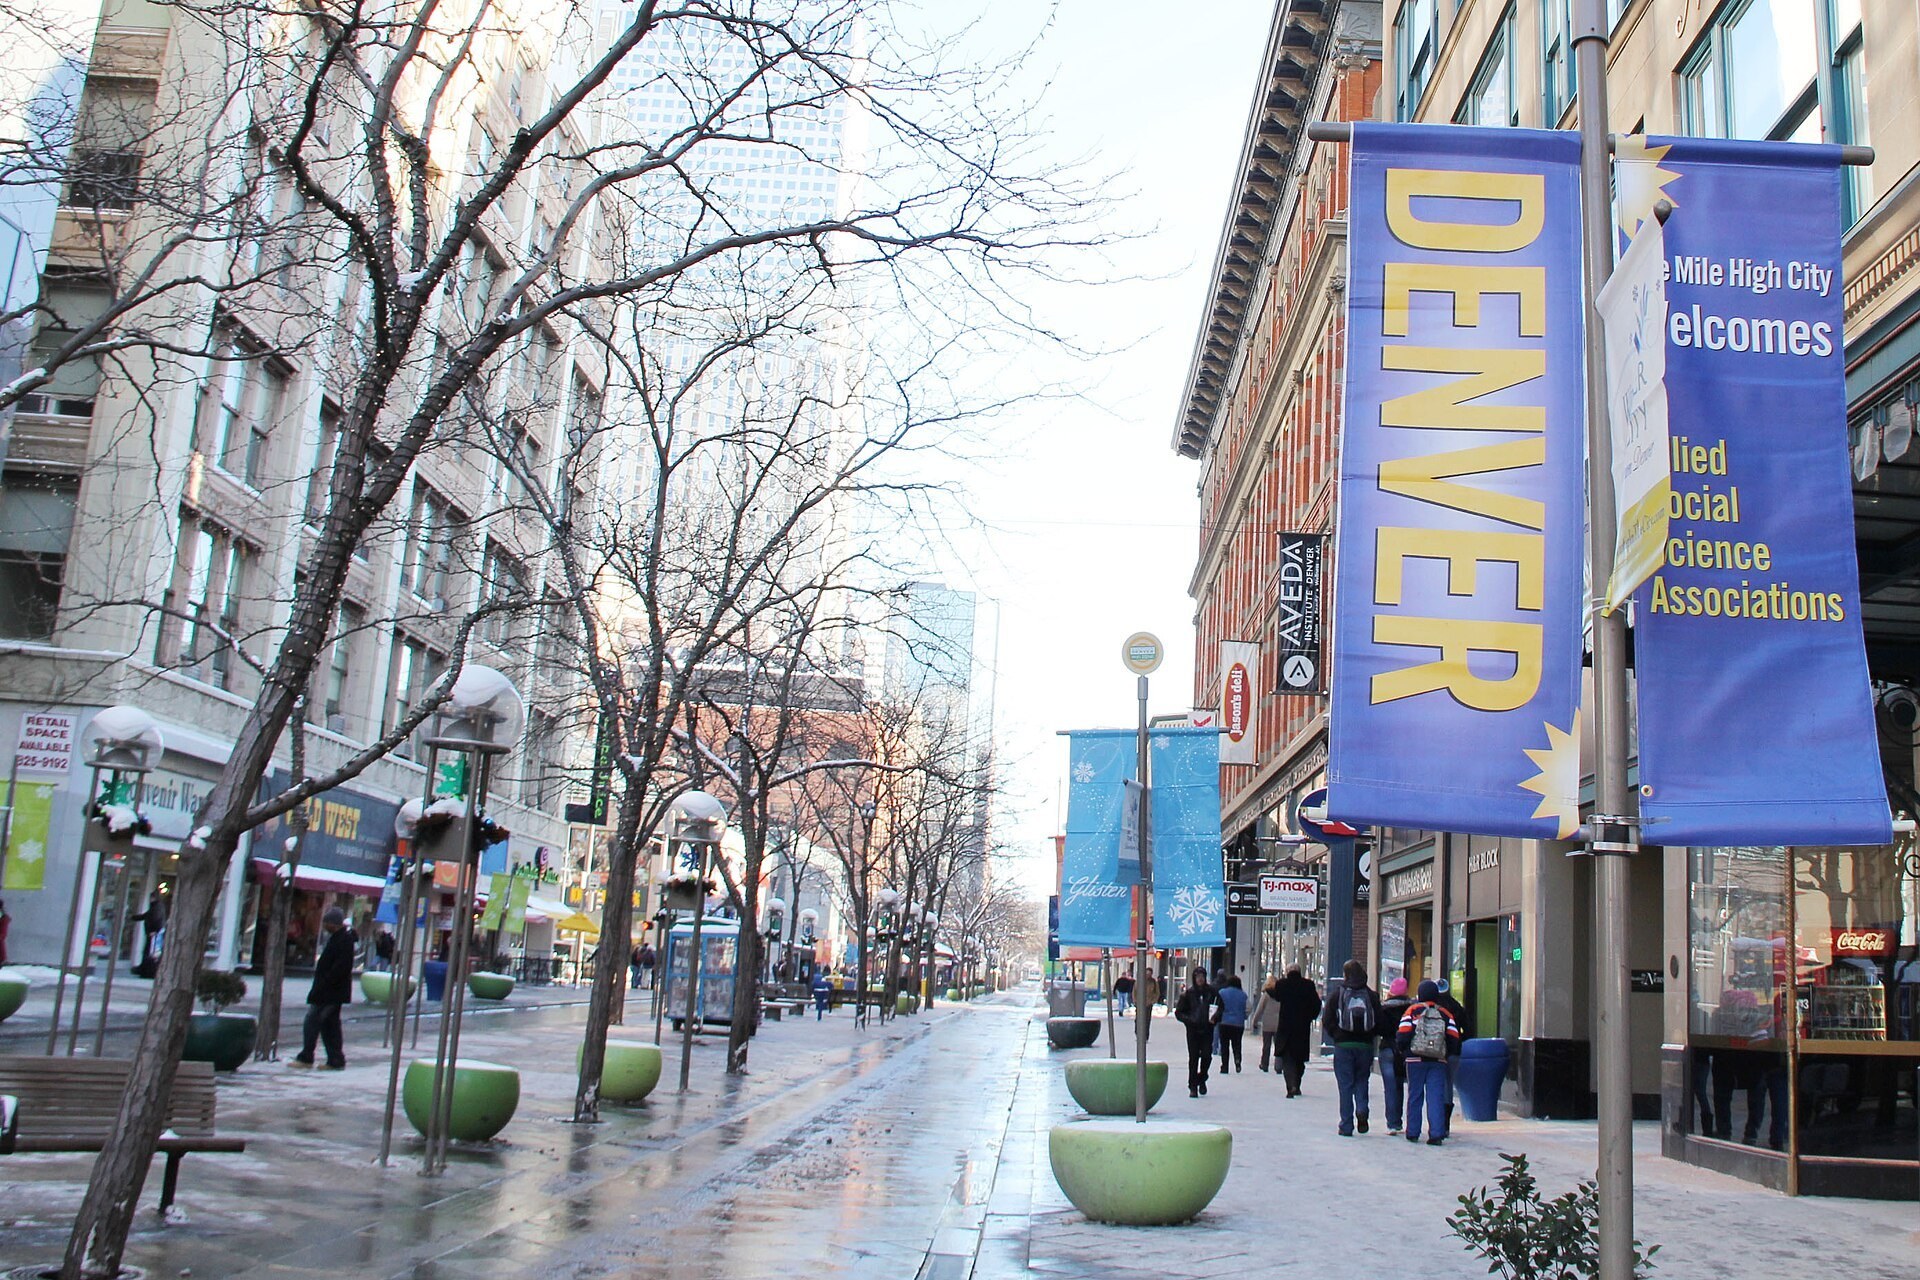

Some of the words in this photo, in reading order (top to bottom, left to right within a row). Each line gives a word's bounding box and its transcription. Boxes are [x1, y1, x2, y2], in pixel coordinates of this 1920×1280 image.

[1674, 255, 1724, 287] Mile
[1729, 258, 1783, 295] High
[1787, 261, 1834, 298] City
[1665, 301, 1834, 358] elcomes
[1371, 167, 1546, 712] DENVER
[1672, 435, 1728, 476] lied
[1669, 484, 1740, 524] ocial
[1306, 547, 1315, 584] DENVER
[1664, 530, 1772, 571] cience
[1279, 540, 1303, 647] AVEDA
[1650, 575, 1846, 622] Associations
[1304, 589, 1314, 641] INSTITUTE
[1231, 669, 1243, 692] deli
[26, 716, 70, 728] RETAIL
[26, 727, 69, 739] SPACE
[19, 740, 72, 753] AVAILABLE
[324, 801, 361, 841] WEST
[1468, 855, 1480, 874] H&R
[1480, 848, 1499, 870] BLOCK
[1064, 874, 1128, 906] Glisten
